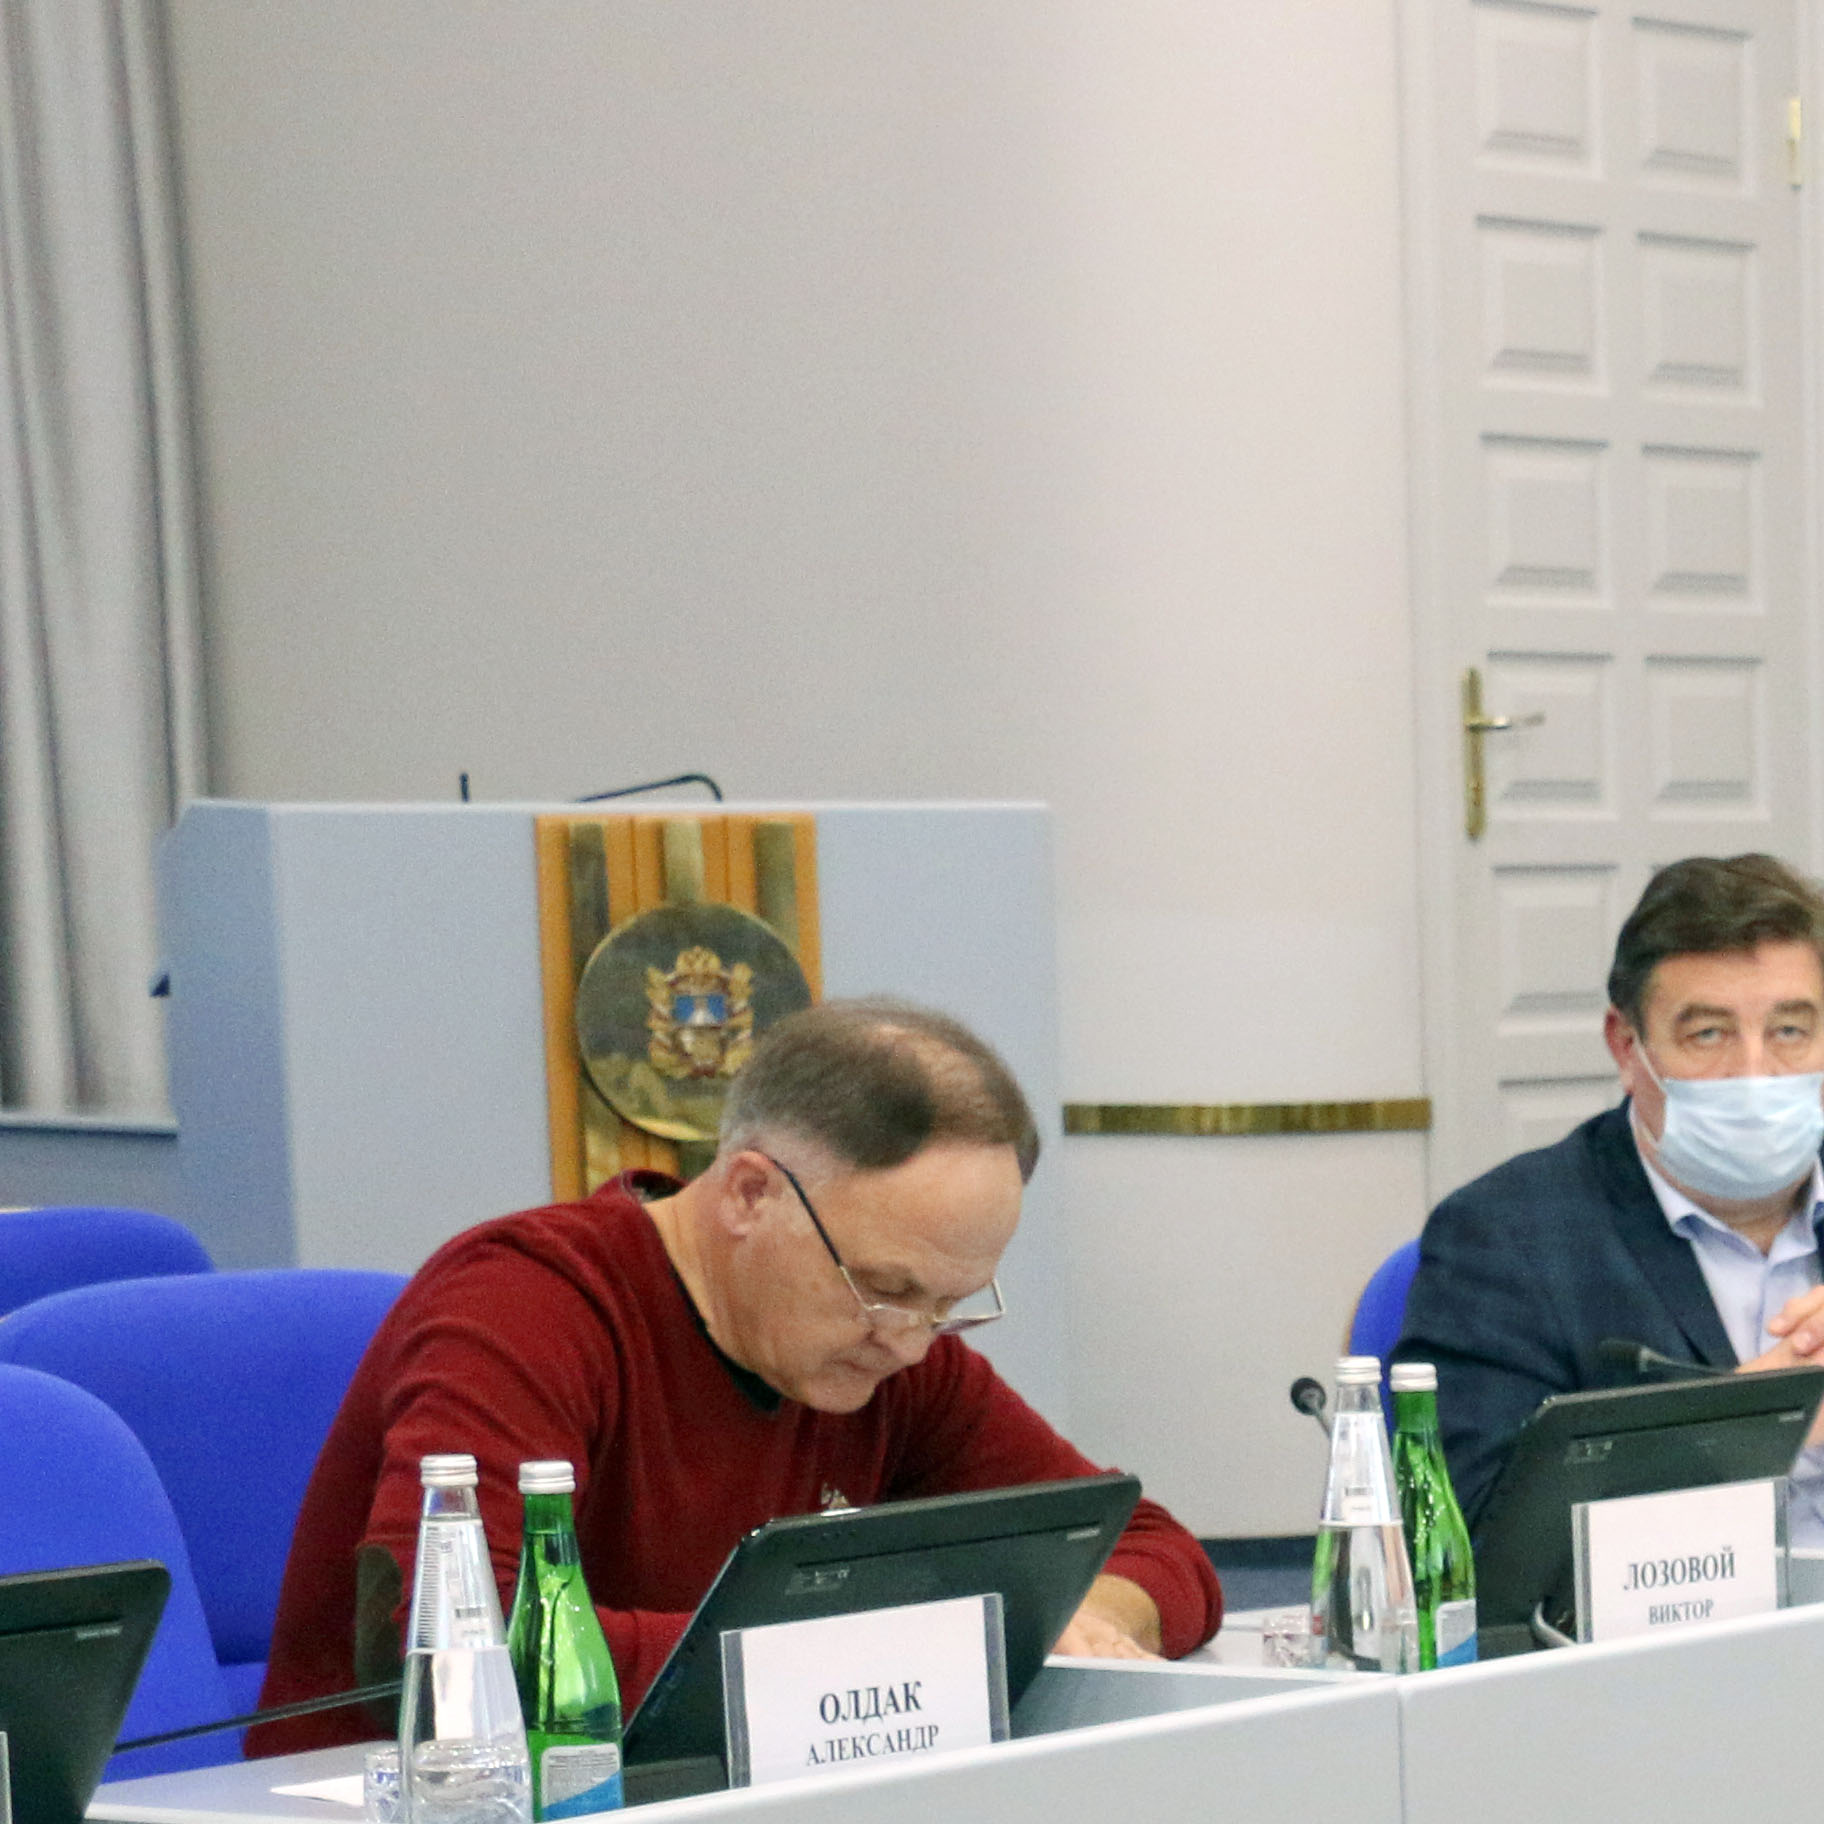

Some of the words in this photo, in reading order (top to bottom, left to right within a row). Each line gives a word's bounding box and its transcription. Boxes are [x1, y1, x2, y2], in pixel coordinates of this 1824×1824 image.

[1622, 1546, 1737, 1591] ЛОЗОВОЙ
[1649, 1598, 1715, 1625] ВИКТОР
[818, 1681, 923, 1725] ОЛДАК
[805, 1725, 940, 1767] АЛЕКСАНДР
